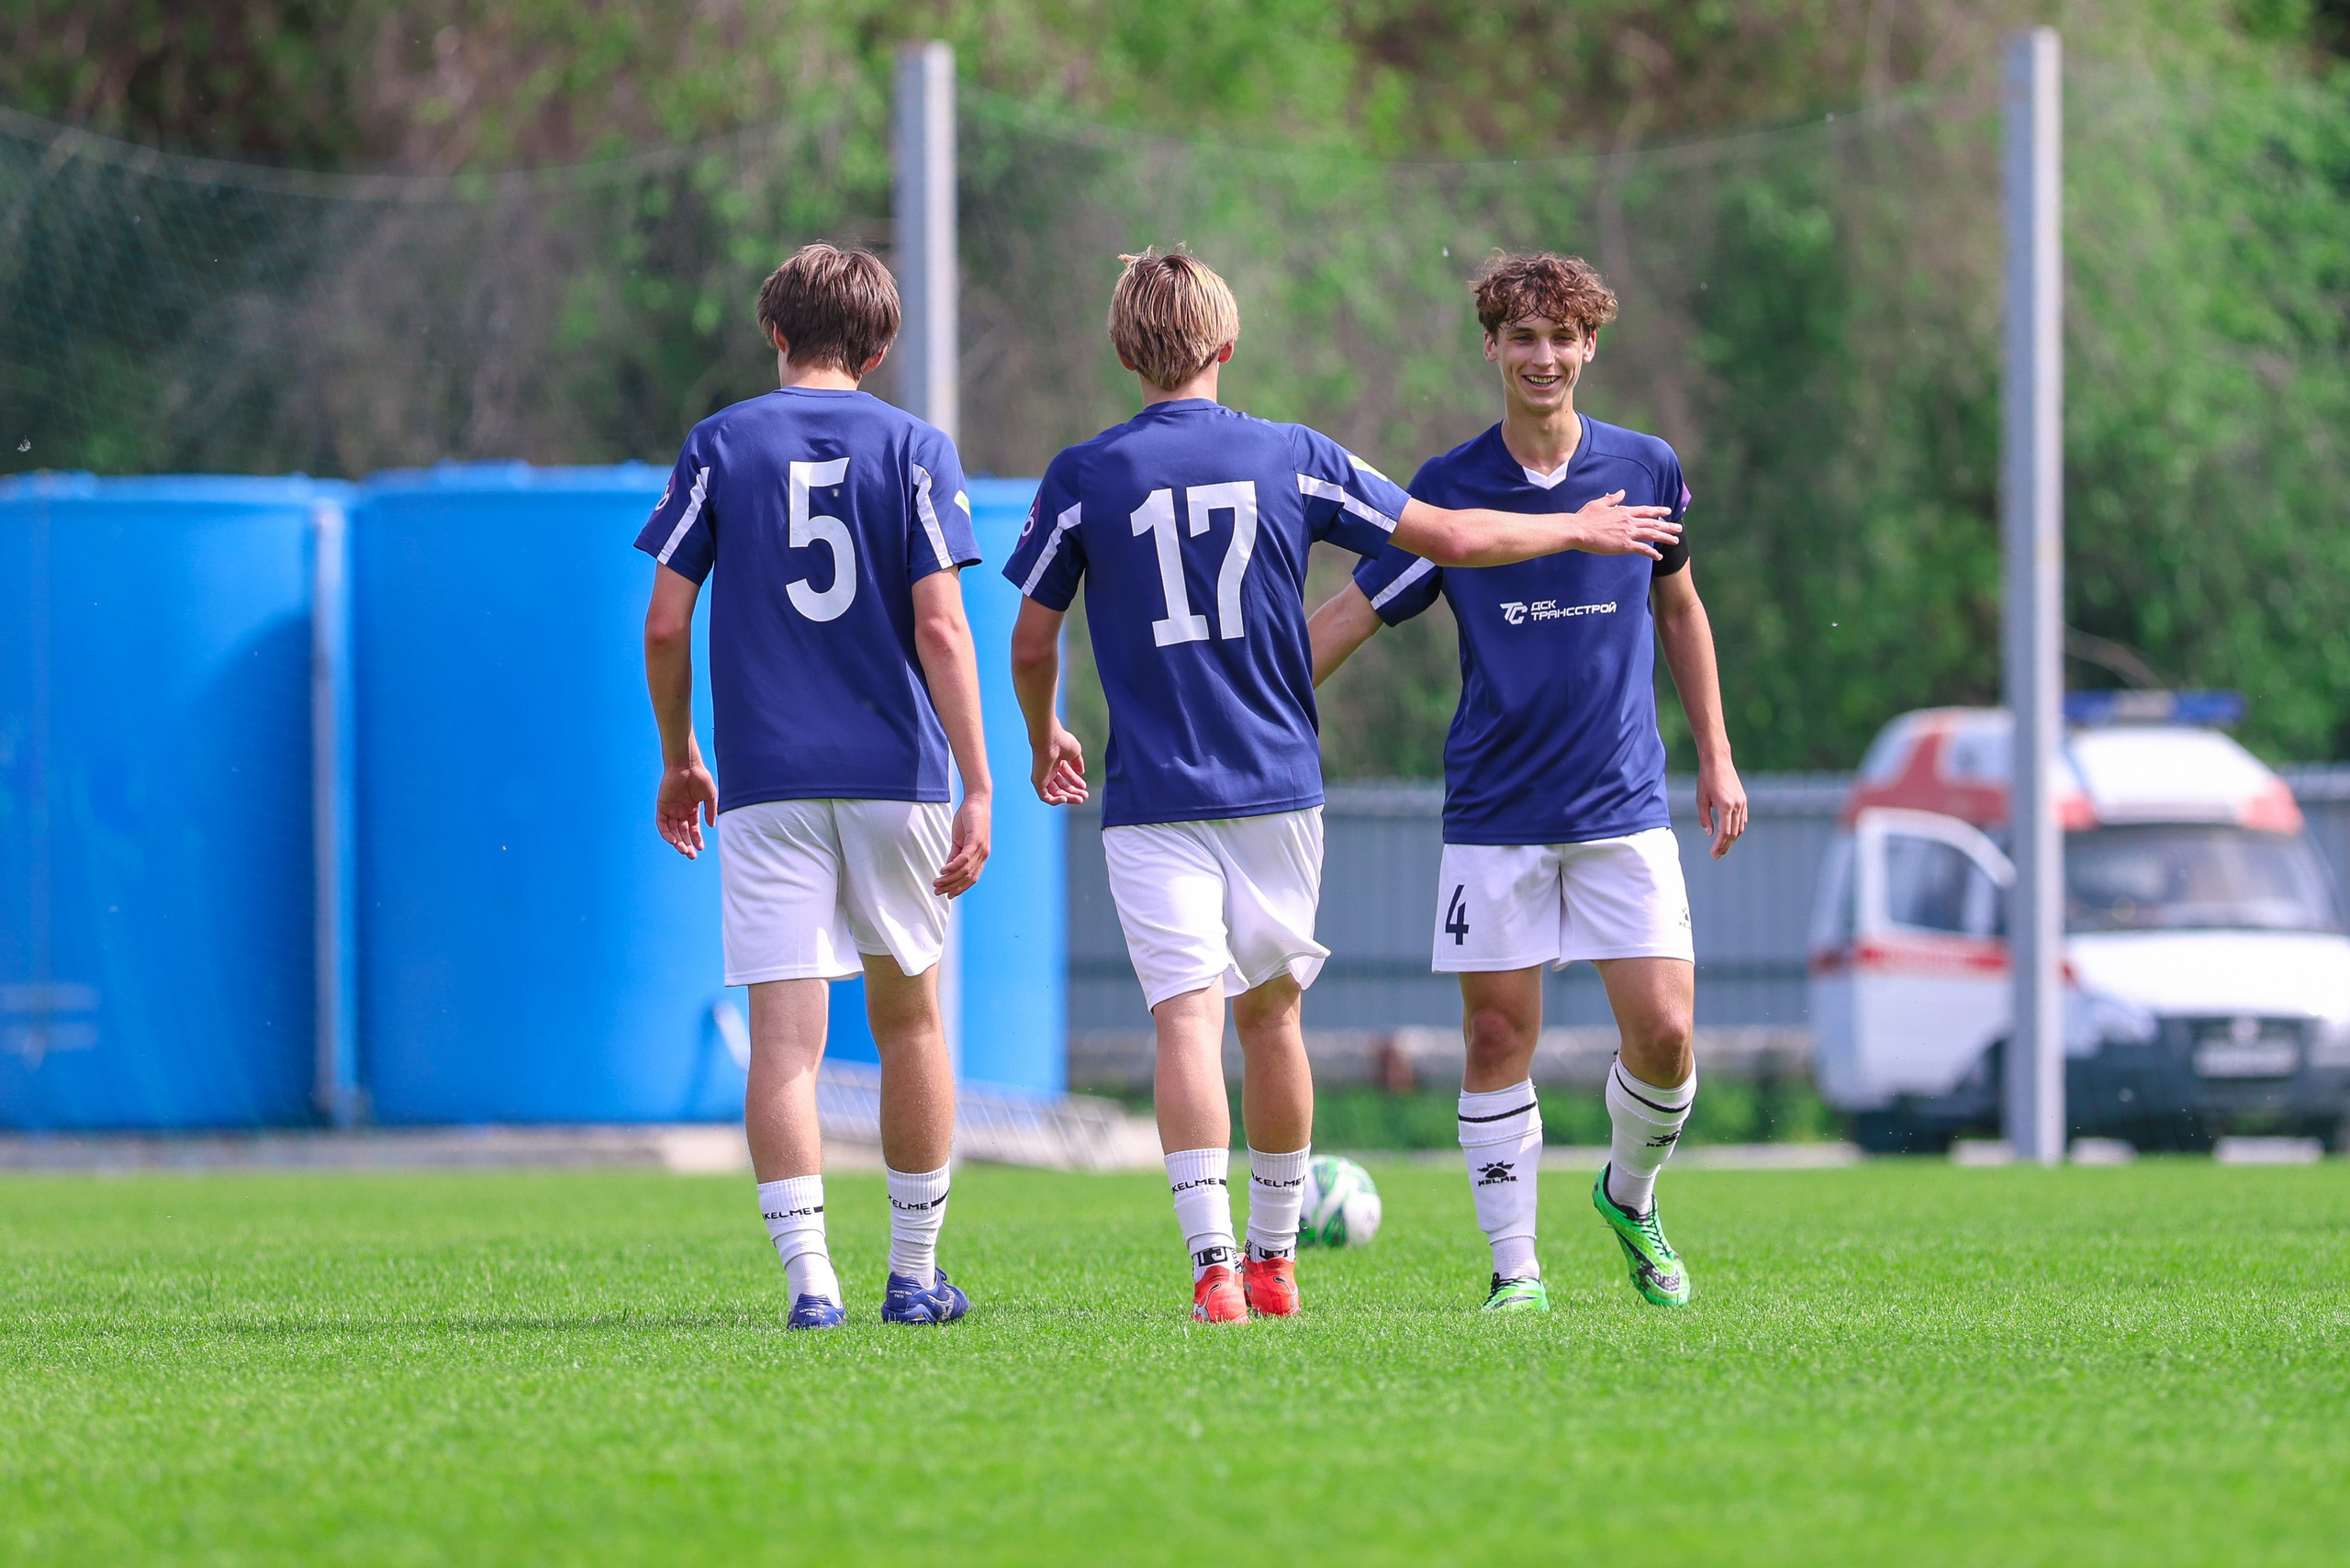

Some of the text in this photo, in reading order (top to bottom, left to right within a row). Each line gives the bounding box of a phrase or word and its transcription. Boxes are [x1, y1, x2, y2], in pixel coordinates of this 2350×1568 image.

[785, 457, 857, 622] 5
[1129, 480, 1258, 648] 17
[1530, 599, 1557, 611] ДСК
[1530, 601, 1617, 621] ТРАНССТРОЙ
[1445, 884, 1470, 946] 4
[1171, 1177, 1217, 1193] KELME
[1255, 1174, 1303, 1188] KELME
[1478, 1175, 1517, 1187] KELME
[763, 1206, 812, 1220] KELME
